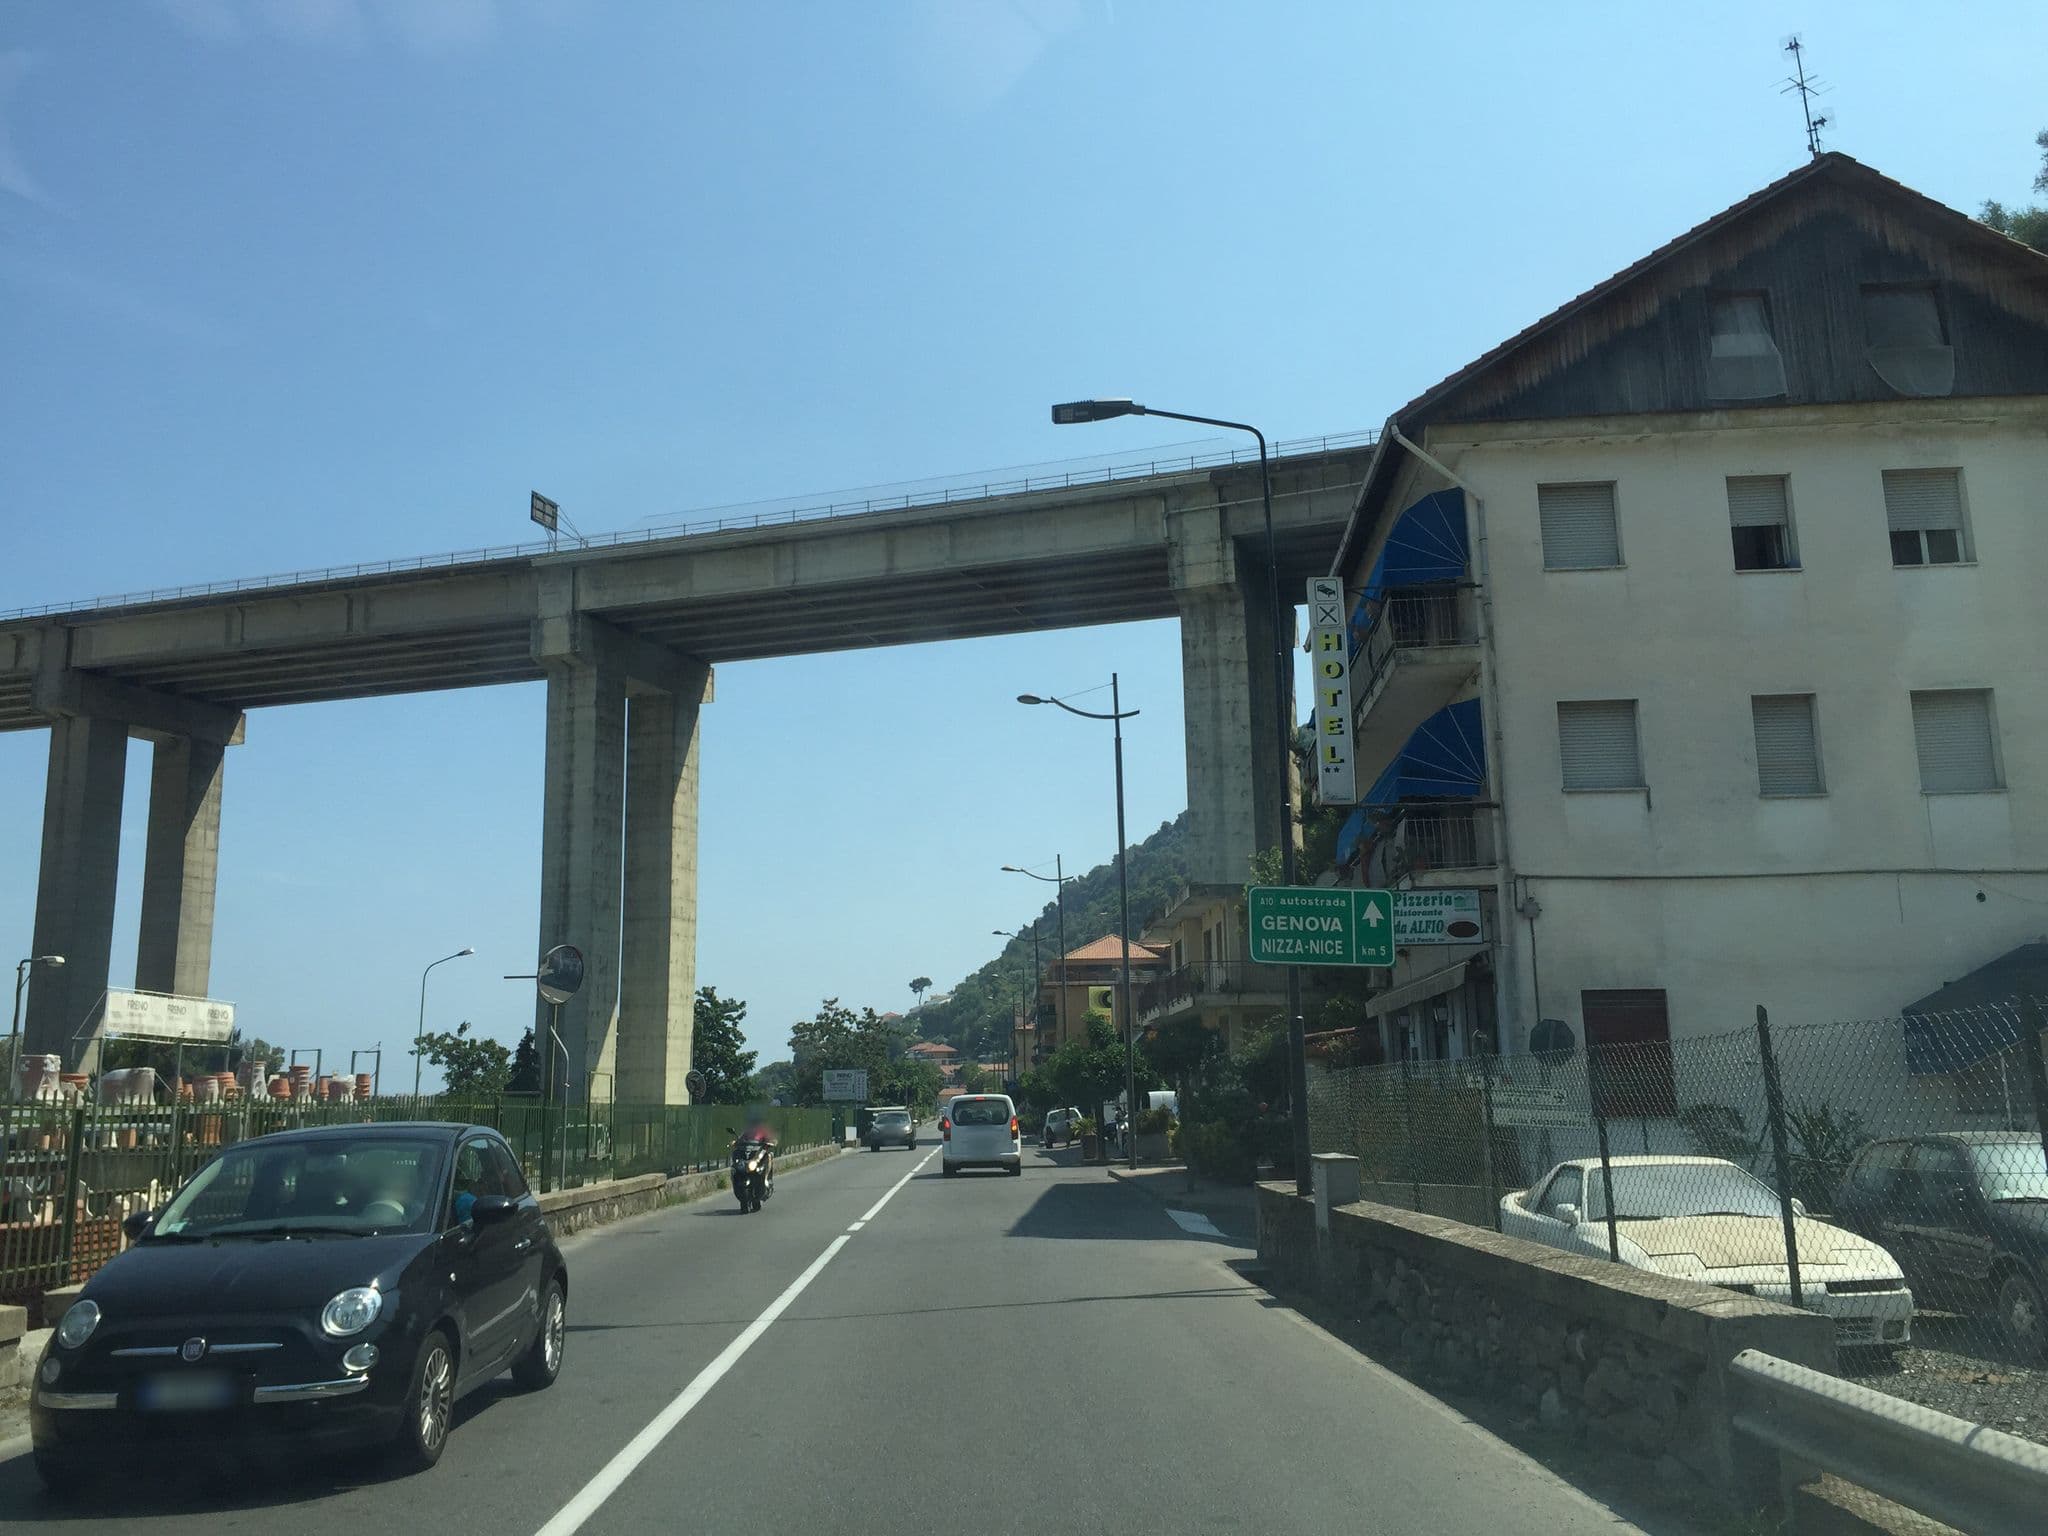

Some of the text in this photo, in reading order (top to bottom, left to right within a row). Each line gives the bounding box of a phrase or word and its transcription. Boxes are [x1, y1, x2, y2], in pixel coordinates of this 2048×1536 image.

[1319, 632, 1345, 764] HOTEL
[1260, 897, 1346, 907] A10 autostrada
[1393, 893, 1453, 908] Pizzeria
[1261, 915, 1343, 932] GENOVA
[1409, 920, 1444, 934] ALFIO
[1361, 945, 1386, 956] km 5
